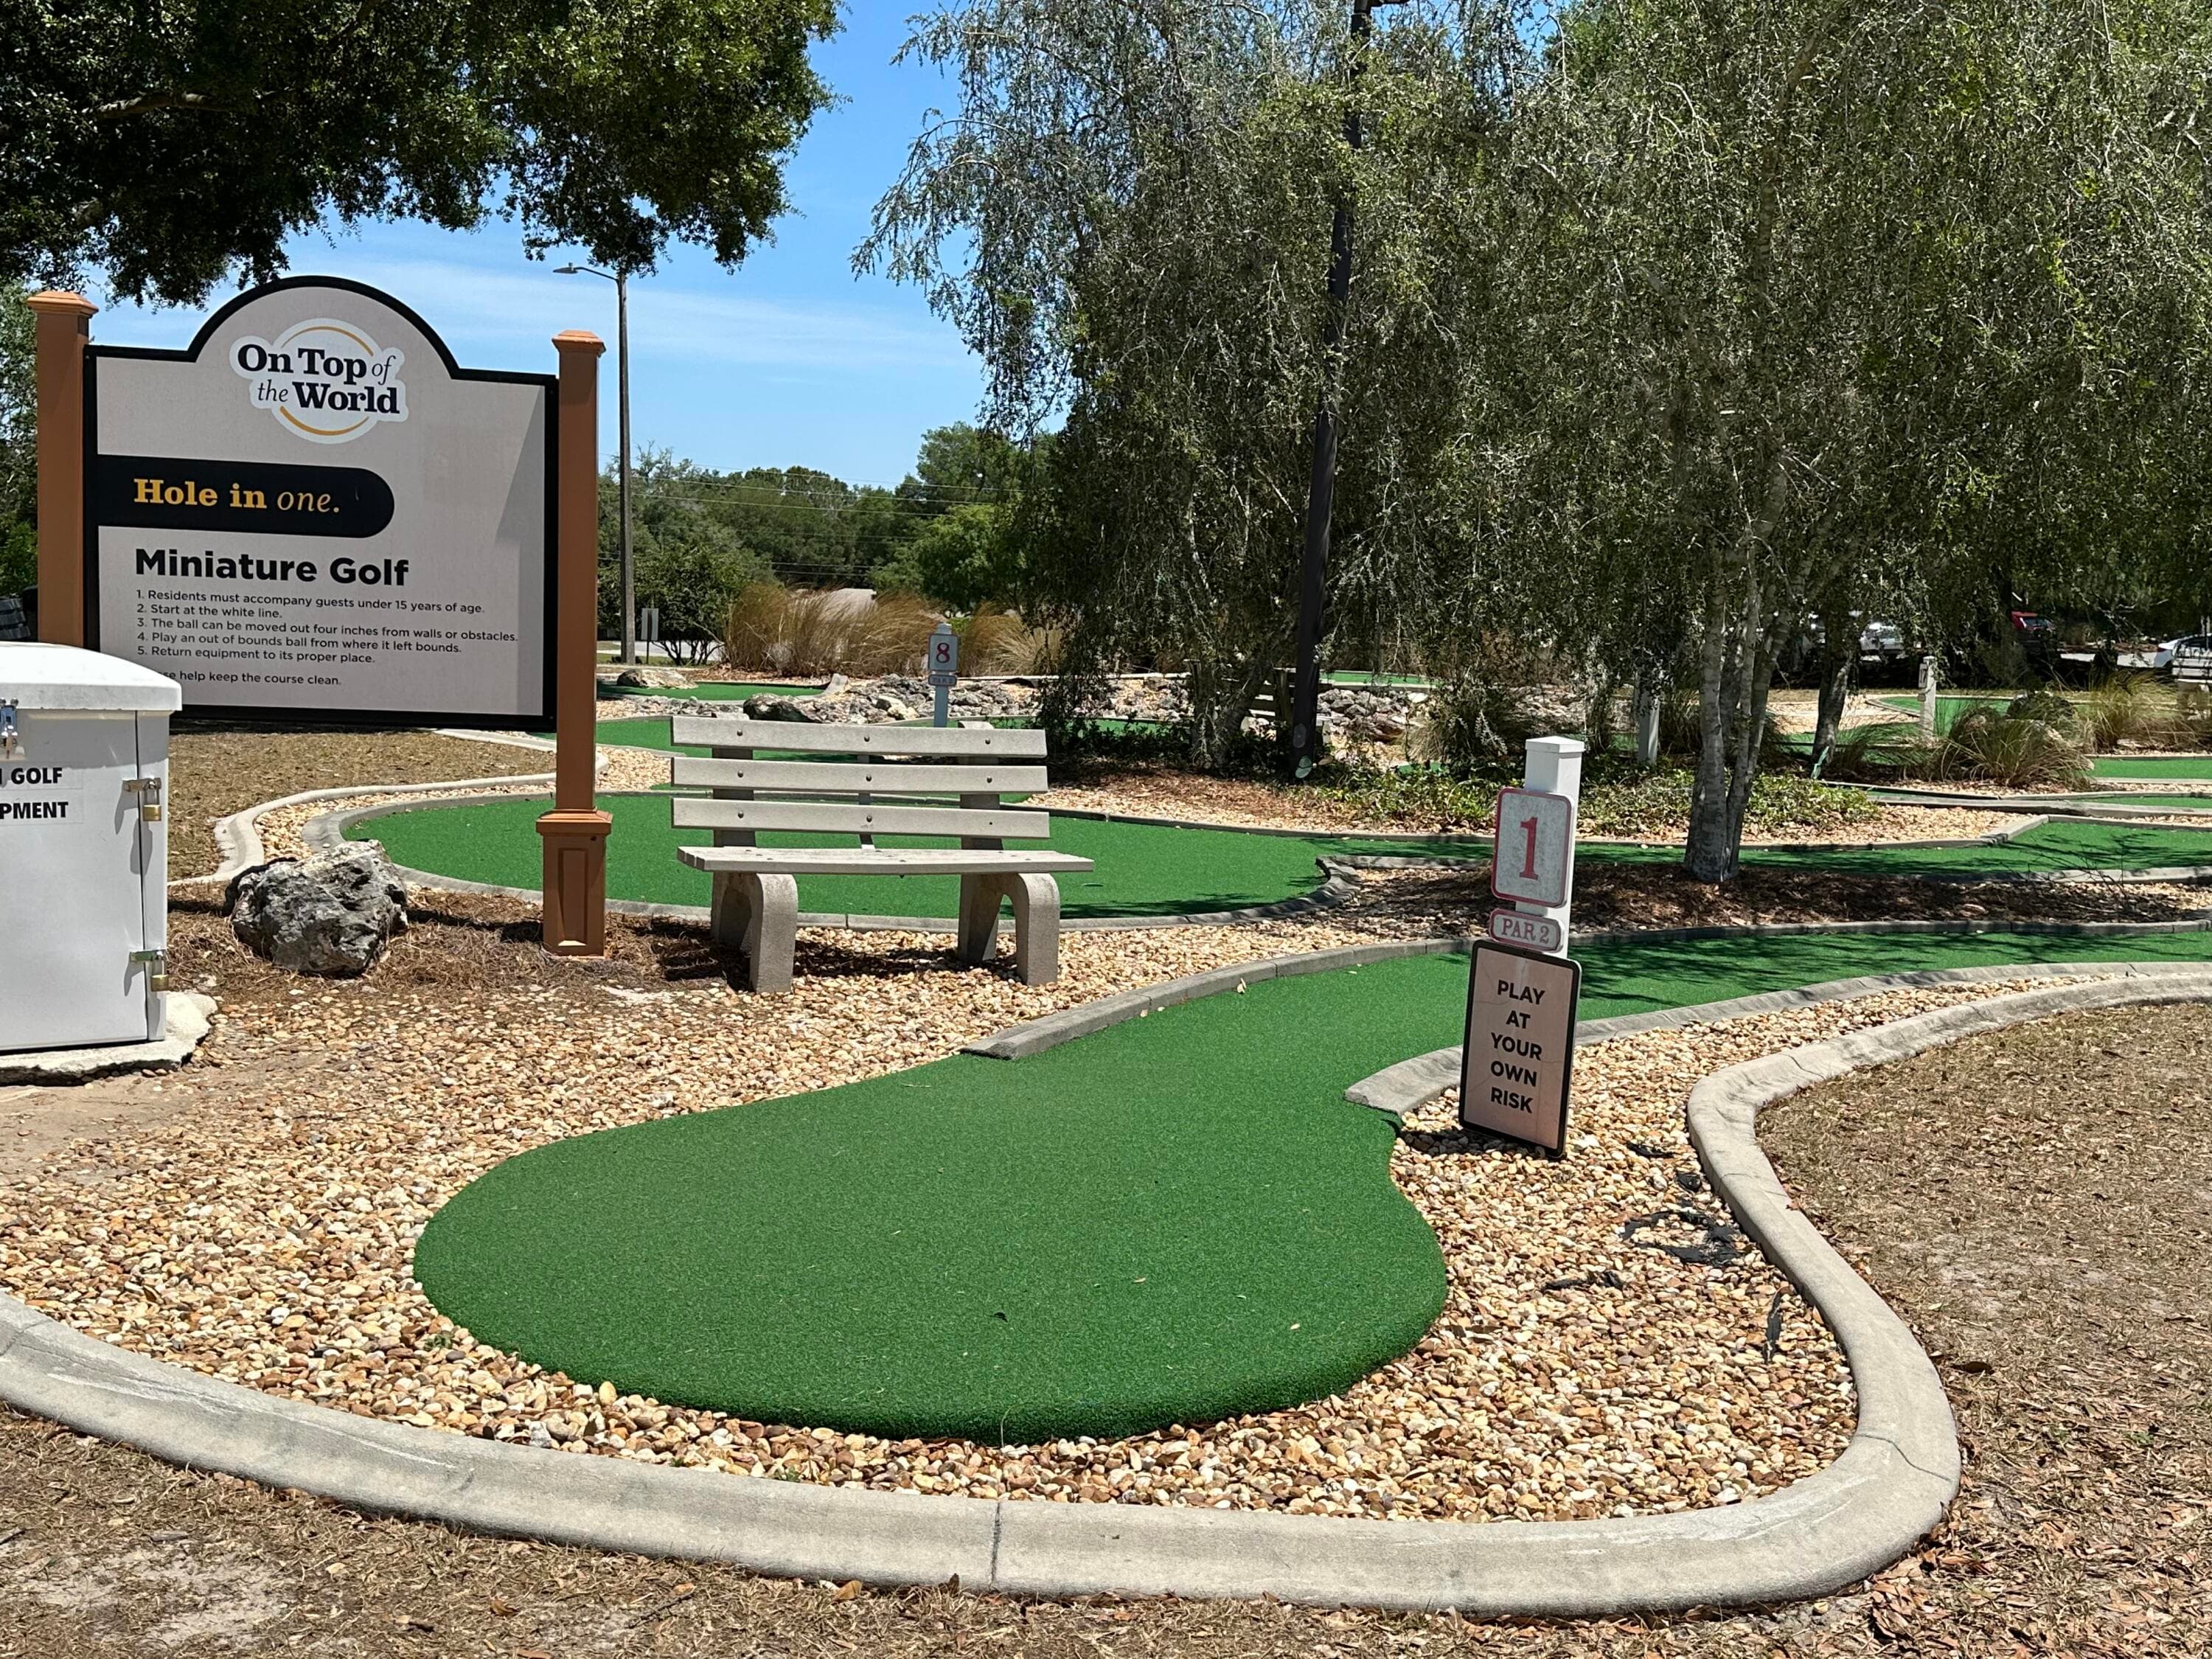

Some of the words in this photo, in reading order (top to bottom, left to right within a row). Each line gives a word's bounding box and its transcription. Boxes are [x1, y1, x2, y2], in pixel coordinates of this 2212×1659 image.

[237, 344, 293, 373] On
[298, 348, 366, 385] Top
[372, 355, 397, 385] of
[258, 379, 288, 402] the
[292, 381, 400, 414] World
[133, 479, 218, 506] Hole
[230, 483, 267, 509] in
[277, 492, 340, 513] one.
[136, 549, 317, 582] Miniature
[330, 557, 408, 585] Golf
[136, 590, 145, 599] 1.
[148, 590, 206, 602] Residents
[210, 594, 240, 602] must
[243, 596, 312, 607] accompany
[316, 598, 354, 608] guests
[358, 599, 392, 609] under
[396, 601, 406, 609] 15
[411, 602, 442, 612] years
[445, 603, 457, 611] of
[460, 605, 485, 613] age.
[137, 604, 147, 613] 2.
[151, 605, 179, 614] Start
[184, 606, 195, 615] at
[199, 606, 218, 615] the
[222, 608, 254, 617] white
[258, 608, 282, 618] line.
[137, 618, 147, 627] 3.
[152, 619, 173, 627] The
[177, 619, 198, 629] ball
[227, 621, 241, 630] be
[246, 623, 286, 633] moved
[290, 625, 310, 633] out
[313, 625, 337, 634] four
[341, 626, 378, 636] inches
[382, 627, 409, 637] from
[414, 629, 442, 639] walls
[445, 631, 457, 639] or
[461, 631, 518, 641] obstacles.
[137, 633, 147, 641] 4.
[153, 633, 177, 644] Play
[199, 636, 218, 644] out
[223, 635, 234, 644] of
[238, 636, 282, 645] bounds
[286, 637, 307, 647] ball
[310, 639, 338, 647] from
[342, 640, 378, 650] where
[382, 641, 389, 650] it
[394, 641, 412, 650] left
[416, 642, 462, 653] bounds.
[138, 646, 147, 655] 5.
[152, 647, 191, 656] Return
[195, 648, 260, 658] equipment
[279, 650, 293, 660] its
[296, 653, 338, 662] proper
[341, 653, 375, 664] place.
[936, 642, 950, 663] 8
[180, 671, 205, 682] help
[209, 672, 238, 683] keep
[242, 673, 260, 682] the
[265, 675, 304, 684] course
[307, 674, 342, 686] clean.
[11, 768, 62, 785] GOLF
[1519, 817, 1539, 880] 1
[1501, 918, 1536, 940] PAR
[1540, 925, 1549, 944] 2
[1498, 979, 1545, 1005] PLAY
[1506, 1010, 1531, 1029] AT
[1491, 1032, 1542, 1061] YOUR
[1490, 1060, 1537, 1087] OWN
[1491, 1087, 1533, 1113] RISK
